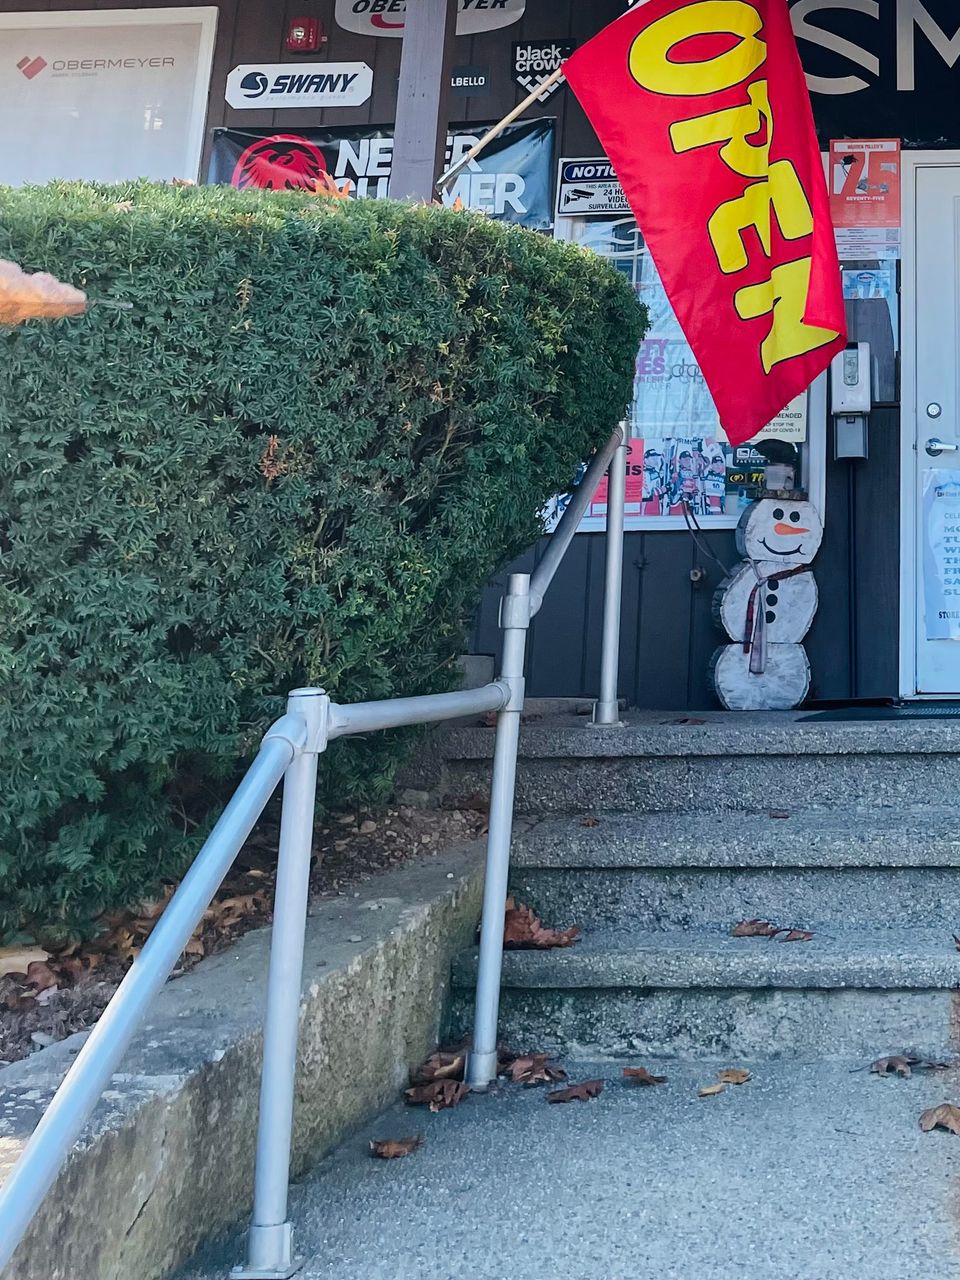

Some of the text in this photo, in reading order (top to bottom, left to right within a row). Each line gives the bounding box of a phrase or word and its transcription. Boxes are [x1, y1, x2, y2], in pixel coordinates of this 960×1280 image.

[516, 45, 561, 61] black
[52, 57, 175, 71] OBERMEYER
[515, 58, 569, 72] crows
[270, 72, 359, 94] SWANY
[451, 76, 485, 87] LBELLO
[334, 135, 483, 177] NER
[571, 165, 618, 178] NOTIC
[335, 172, 529, 215] SUMER
[628, 0, 843, 375] OPEN
[607, 195, 629, 203] VIDE
[938, 611, 960, 619] STORE
